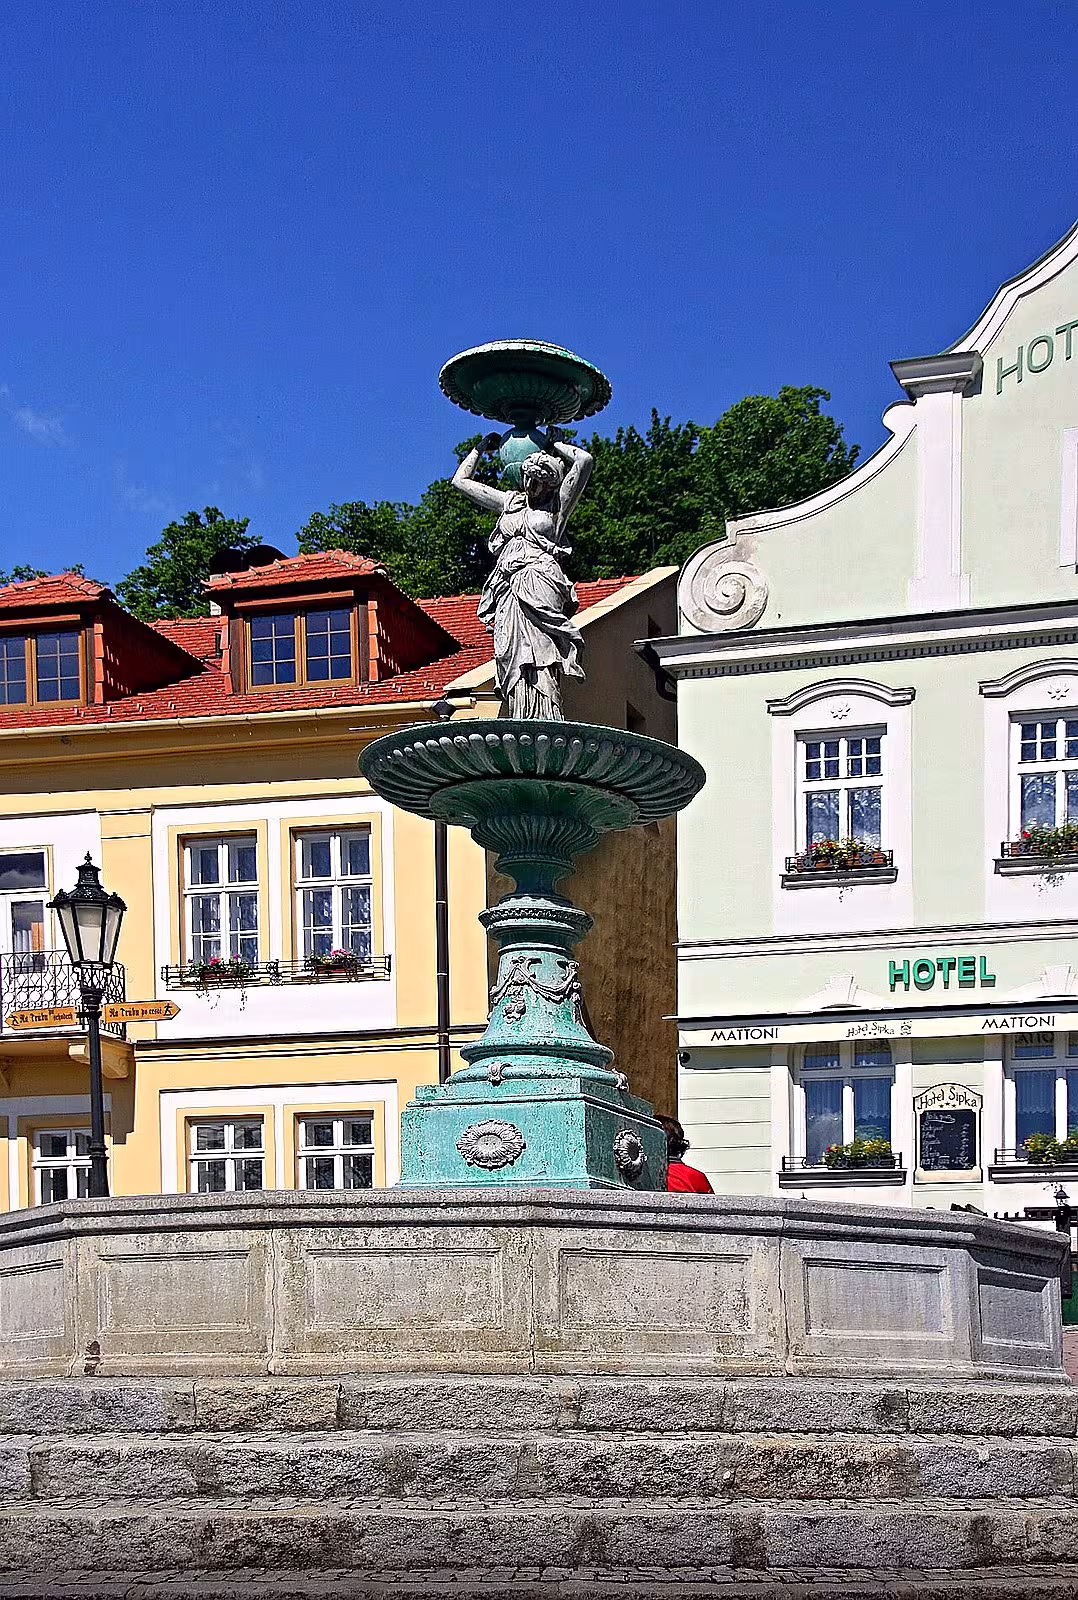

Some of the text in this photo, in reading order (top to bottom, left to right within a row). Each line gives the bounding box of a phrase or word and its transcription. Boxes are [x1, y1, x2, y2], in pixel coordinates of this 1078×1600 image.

[889, 956, 996, 991] HOTEL
[109, 1007, 119, 1017] Na
[981, 1015, 1056, 1030] MATTONI
[710, 1027, 779, 1042] MATTONI
[845, 1023, 869, 1038] Hotel
[917, 1088, 945, 1110] Hotel
